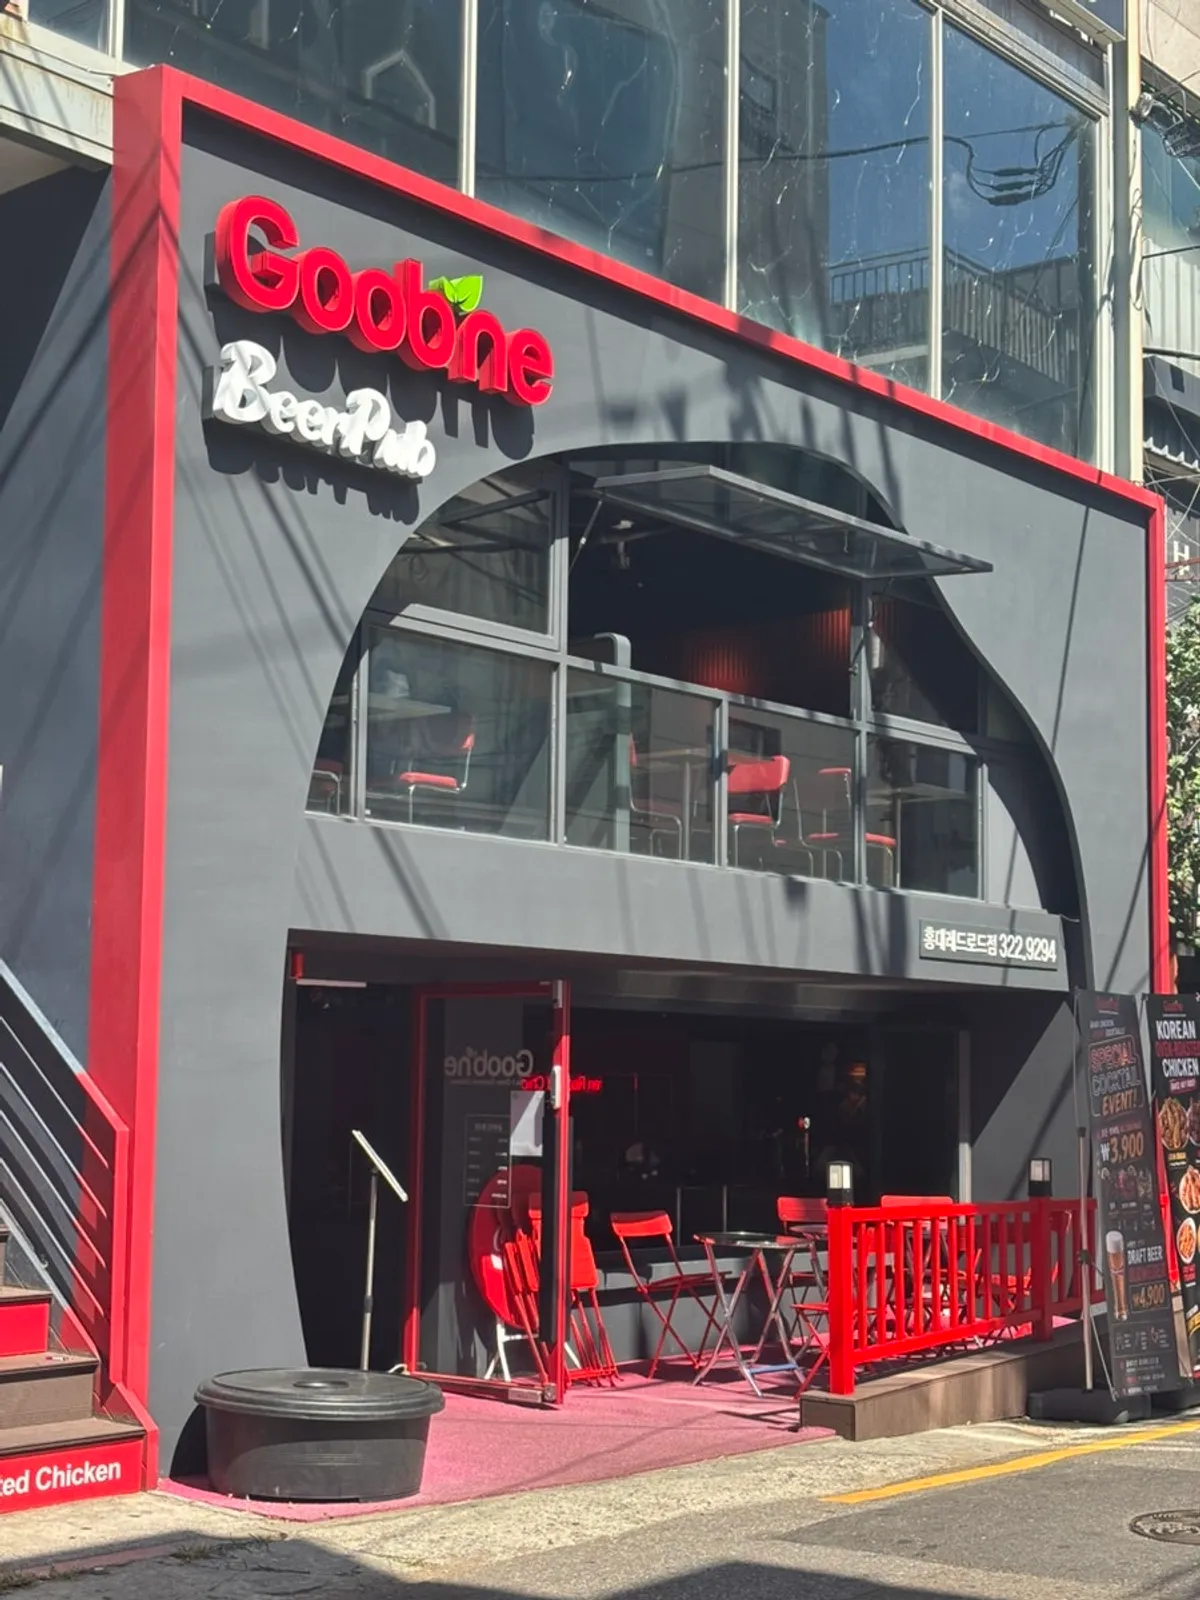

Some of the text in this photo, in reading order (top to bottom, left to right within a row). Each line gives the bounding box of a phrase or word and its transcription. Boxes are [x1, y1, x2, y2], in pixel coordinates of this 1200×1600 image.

[215, 195, 554, 405] Goobne
[924, 926, 1057, 963] 홍대레드로드점 322.9294
[1156, 1020, 1196, 1039] KOREAN
[1091, 1041, 1136, 1073] SPECIAL
[1162, 1058, 1199, 1077] CHICKEN
[1102, 1088, 1137, 1116] EVENT!
[1127, 1245, 1163, 1265] DRAFT BEER
[35, 1460, 121, 1490] Chicken
